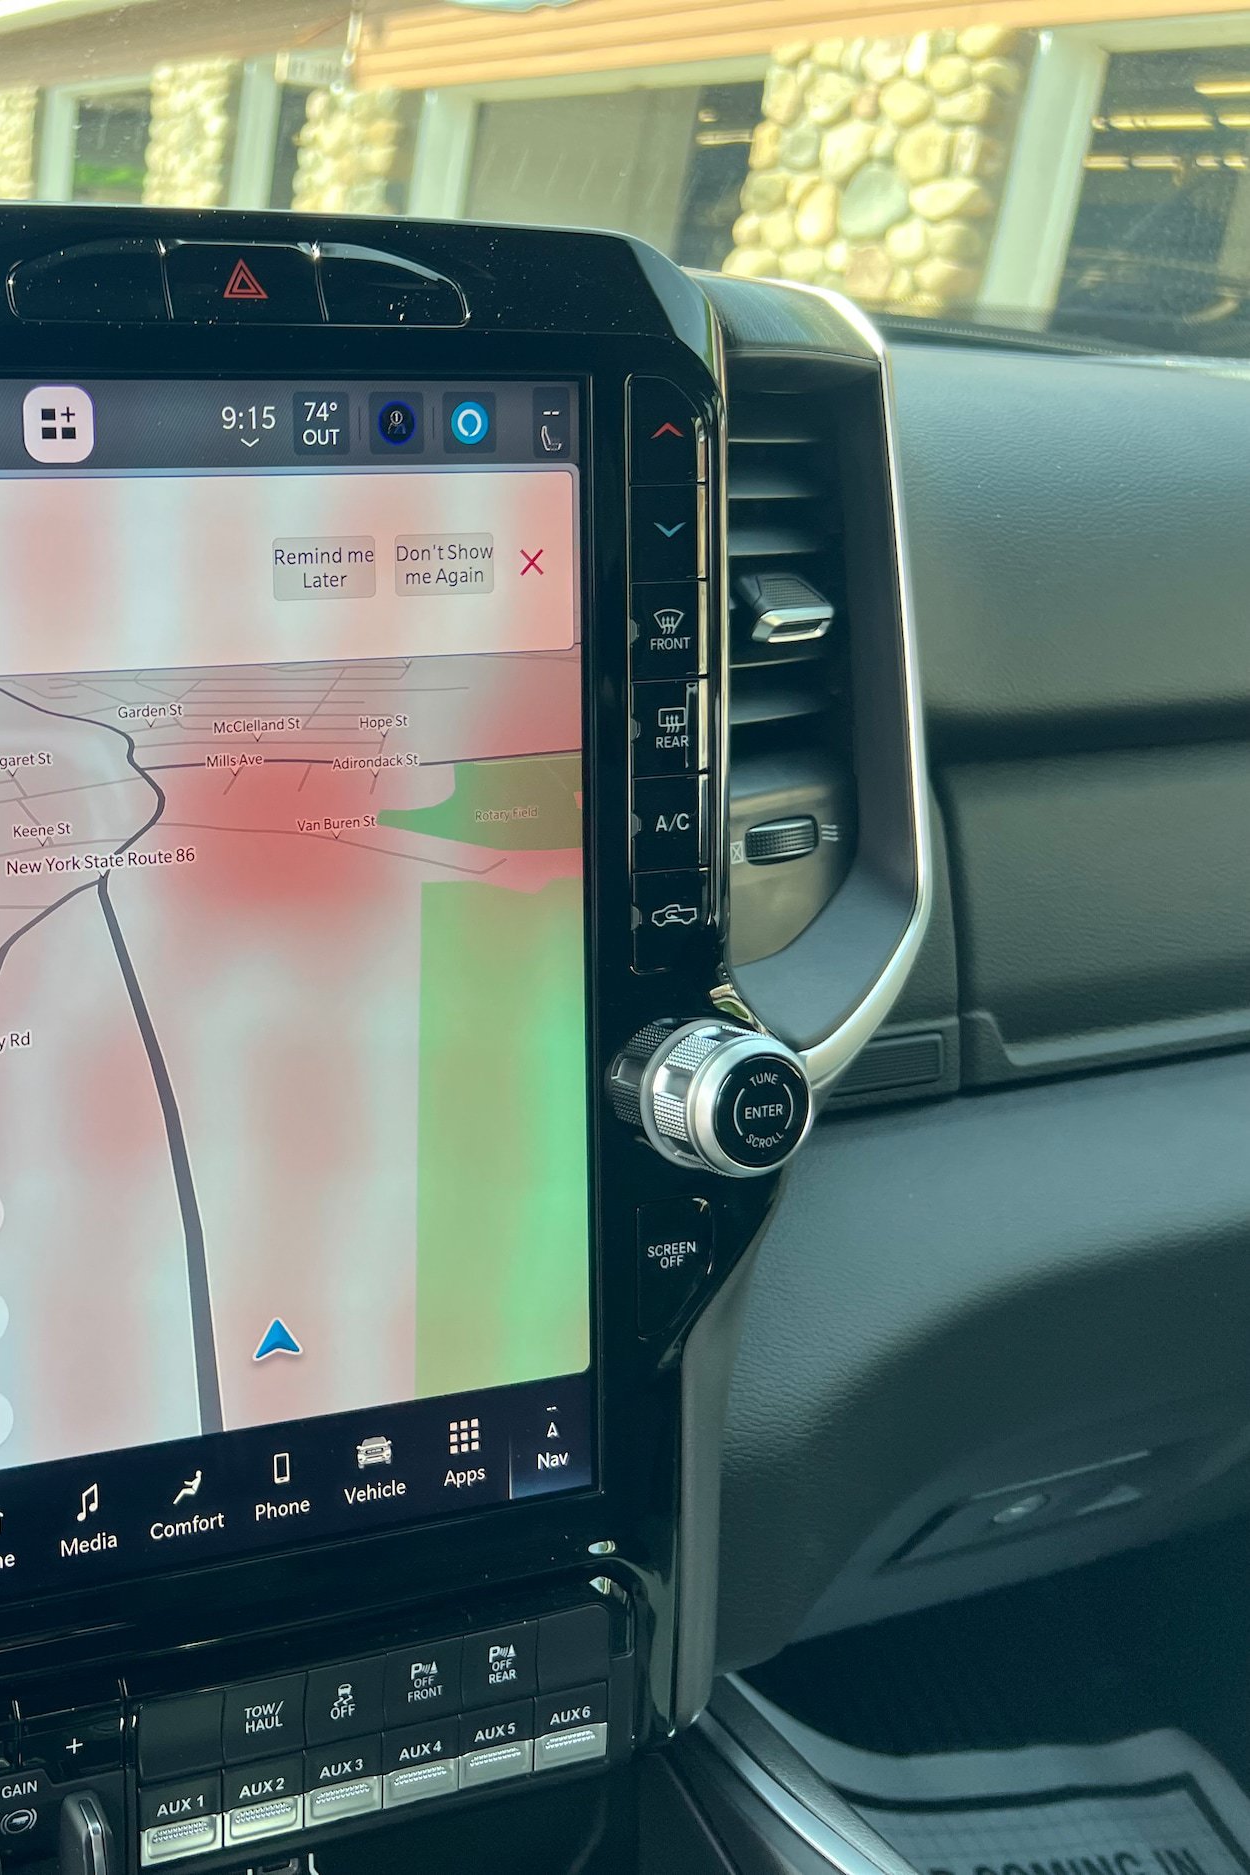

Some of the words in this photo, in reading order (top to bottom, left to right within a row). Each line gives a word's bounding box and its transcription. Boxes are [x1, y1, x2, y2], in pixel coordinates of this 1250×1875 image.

[221, 406, 276, 430] 9:15
[303, 402, 338, 421] 74°
[302, 428, 339, 446] OUT
[273, 546, 342, 565] Remind
[347, 550, 374, 563] me
[395, 542, 444, 562] Don't
[446, 543, 493, 561] Show
[302, 570, 347, 589] Later
[404, 569, 432, 584] me
[436, 566, 483, 589] Again
[650, 637, 690, 650] FRONT
[118, 704, 165, 719] Garden
[167, 703, 183, 717] St
[213, 718, 283, 734] McClelland
[286, 716, 301, 731] St
[359, 716, 392, 731] Hope
[392, 714, 408, 728] St
[655, 735, 689, 748] REAR
[38, 752, 52, 765] St
[206, 755, 236, 769] Mills
[236, 753, 263, 767] Ave
[332, 755, 402, 769] Adirondack
[404, 753, 419, 767] St
[475, 808, 506, 823] Rotary
[508, 806, 538, 819] Field
[655, 813, 690, 832] A/C
[13, 824, 54, 838] Keene
[57, 821, 71, 835] St
[297, 819, 321, 833] Van
[325, 816, 358, 831] Buren
[362, 815, 376, 829] St
[6, 860, 42, 876] New
[45, 857, 81, 873] York
[83, 855, 124, 871] State
[128, 852, 171, 867] Route
[175, 848, 196, 865] 86
[10, 1032, 31, 1047] Rd
[749, 1072, 779, 1087] TUNE
[744, 1103, 784, 1120] ENTER
[746, 1132, 784, 1148] SCROLL
[647, 1240, 697, 1258] SCREEN
[659, 1254, 685, 1269] OFF
[537, 1451, 569, 1471] Nav
[443, 1465, 487, 1489] Apps
[344, 1478, 407, 1504] Vehicle
[254, 1495, 311, 1521] Phone
[150, 1512, 225, 1540] Comfort
[59, 1531, 119, 1558] Media
[491, 1658, 513, 1672] OFF
[413, 1675, 436, 1690] OFF
[488, 1669, 517, 1685] REAR
[407, 1685, 444, 1703] FRONT
[244, 1700, 285, 1720] TOW/
[330, 1703, 356, 1721] OFF
[549, 1710, 581, 1727] AUX
[584, 1707, 592, 1720] 6
[245, 1715, 284, 1734] HAUL
[474, 1727, 507, 1745] AUX
[510, 1723, 518, 1737] 5
[398, 1745, 433, 1763] AUX
[433, 1740, 444, 1755] 4
[319, 1762, 352, 1780] AUX
[355, 1758, 364, 1771] 3
[0, 1779, 39, 1798] GAIN
[238, 1780, 273, 1799] AUX
[276, 1777, 286, 1791] 2
[156, 1798, 193, 1818] AUX
[196, 1794, 204, 1808] 1
